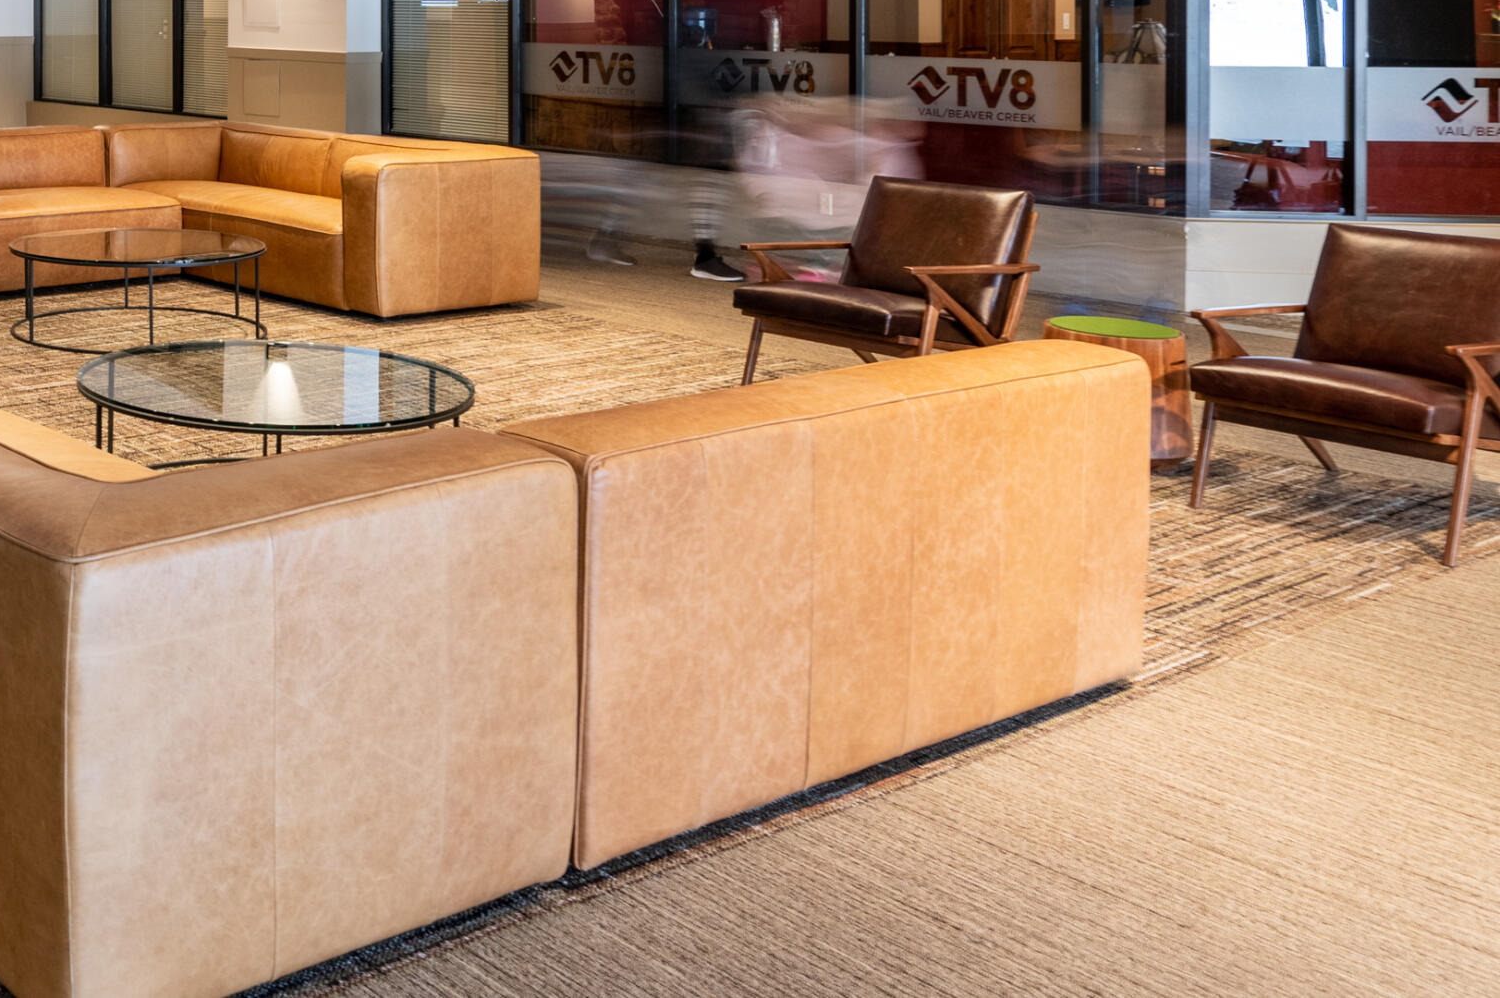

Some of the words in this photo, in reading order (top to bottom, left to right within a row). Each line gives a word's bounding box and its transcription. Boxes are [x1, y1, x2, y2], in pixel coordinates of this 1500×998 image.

[575, 51, 636, 86] TV8
[742, 58, 815, 97] TV8
[946, 66, 1036, 110] TV8
[918, 107, 994, 121] VAIL/BEAVER
[996, 112, 1036, 123] CREEK
